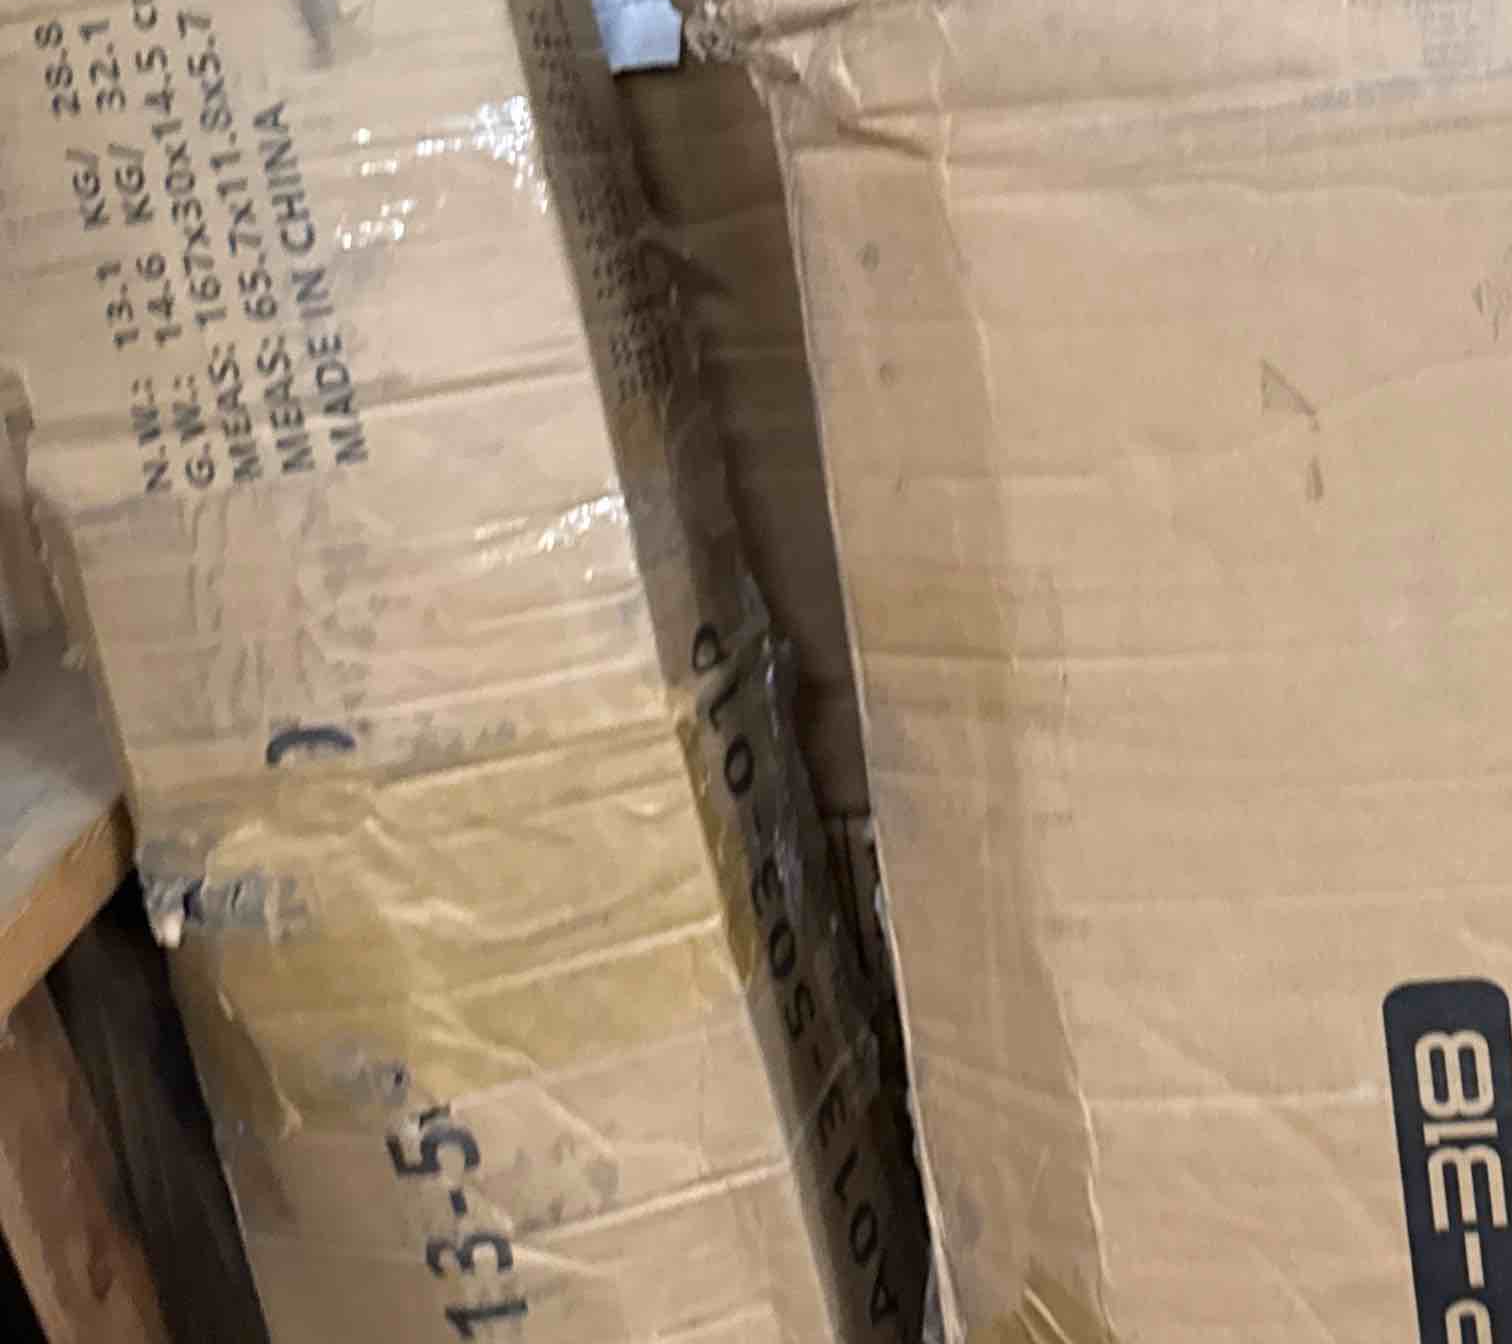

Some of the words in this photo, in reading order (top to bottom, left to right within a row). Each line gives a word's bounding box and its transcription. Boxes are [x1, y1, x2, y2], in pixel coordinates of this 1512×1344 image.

[34, 20, 81, 118] 28.8
[79, 19, 126, 111] 32.1
[66, 148, 110, 231] KG/
[107, 142, 153, 226] KG/
[254, 98, 316, 255] CHINA
[96, 259, 139, 350] 13.1
[136, 253, 182, 348] 14.6
[291, 267, 335, 320] IN
[208, 342, 263, 482] MEAS:
[256, 335, 316, 474] MEAS:
[306, 334, 369, 465] MADE
